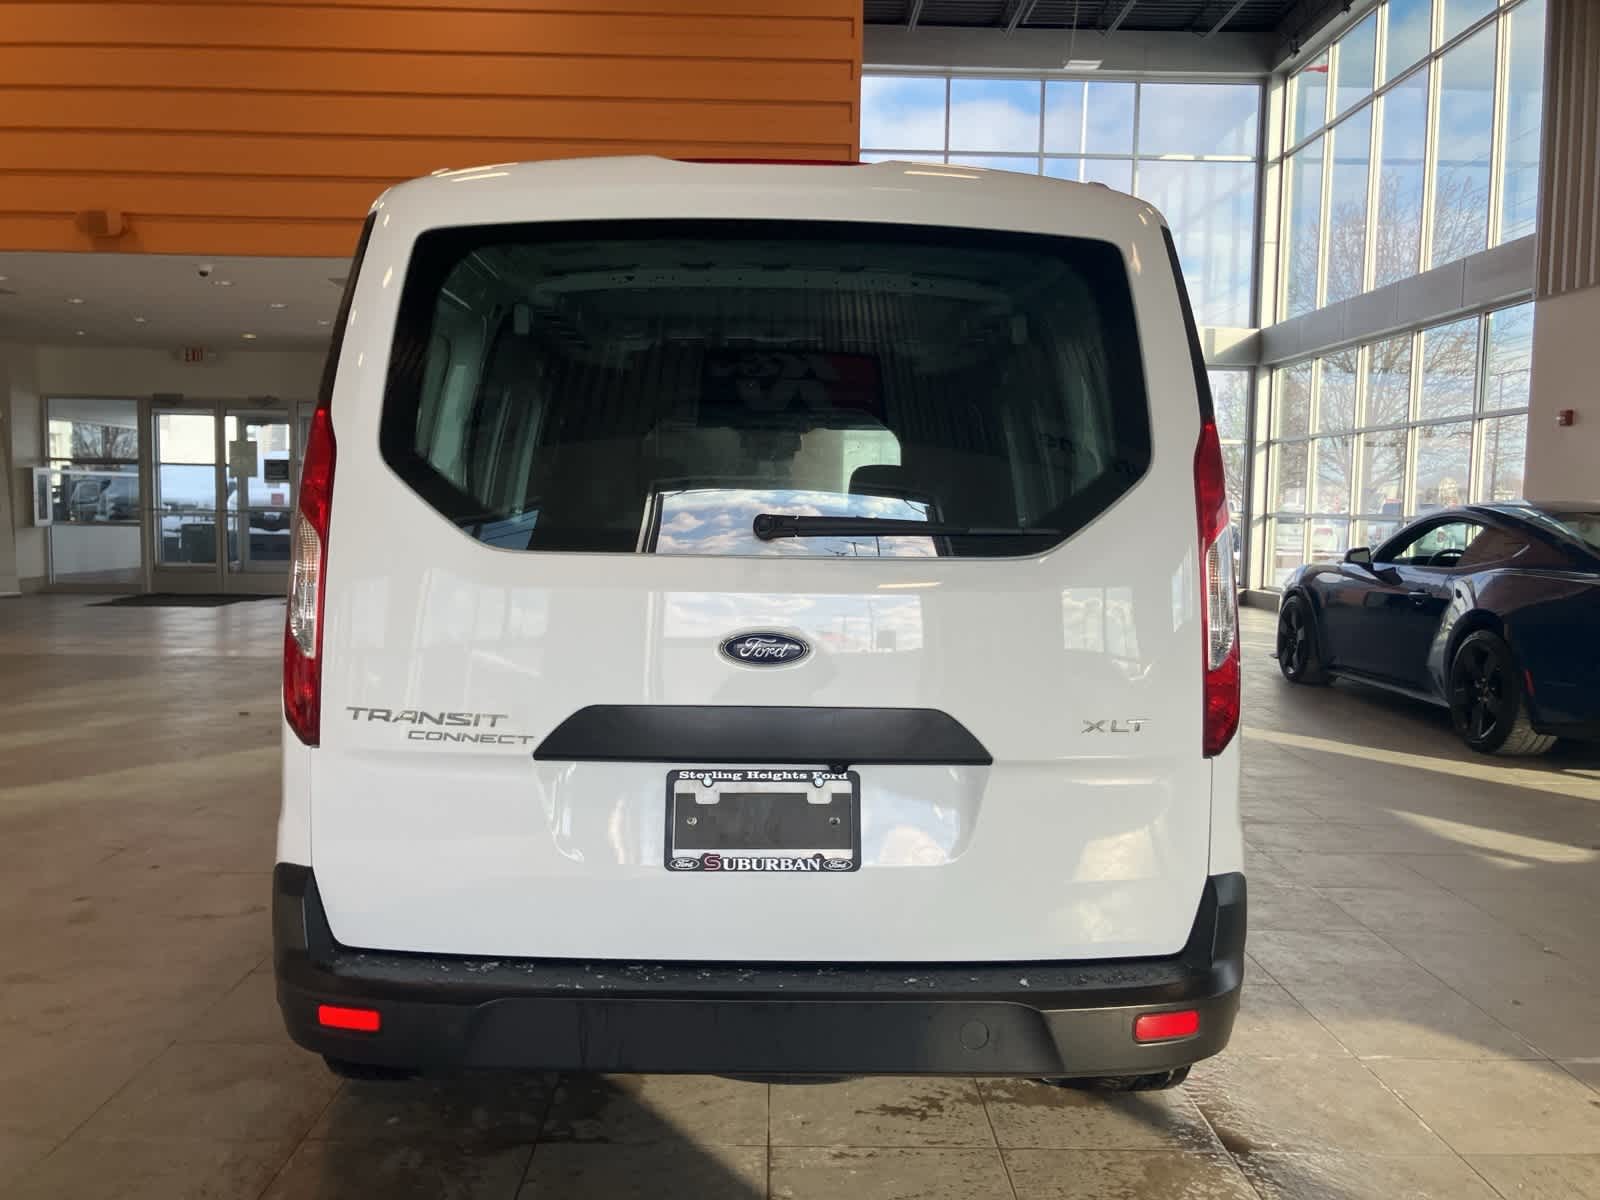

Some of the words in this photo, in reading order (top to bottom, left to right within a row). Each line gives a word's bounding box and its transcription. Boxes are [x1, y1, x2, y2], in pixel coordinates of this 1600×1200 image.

[740, 637, 789, 658] Ford
[346, 706, 508, 727] TRANSIT
[1081, 718, 1150, 734] XLT
[407, 730, 535, 745] CONNECT
[679, 771, 744, 781] Sterling
[747, 771, 808, 781] Heights
[812, 771, 848, 781] Ford
[703, 853, 821, 871] SUBURBAN
